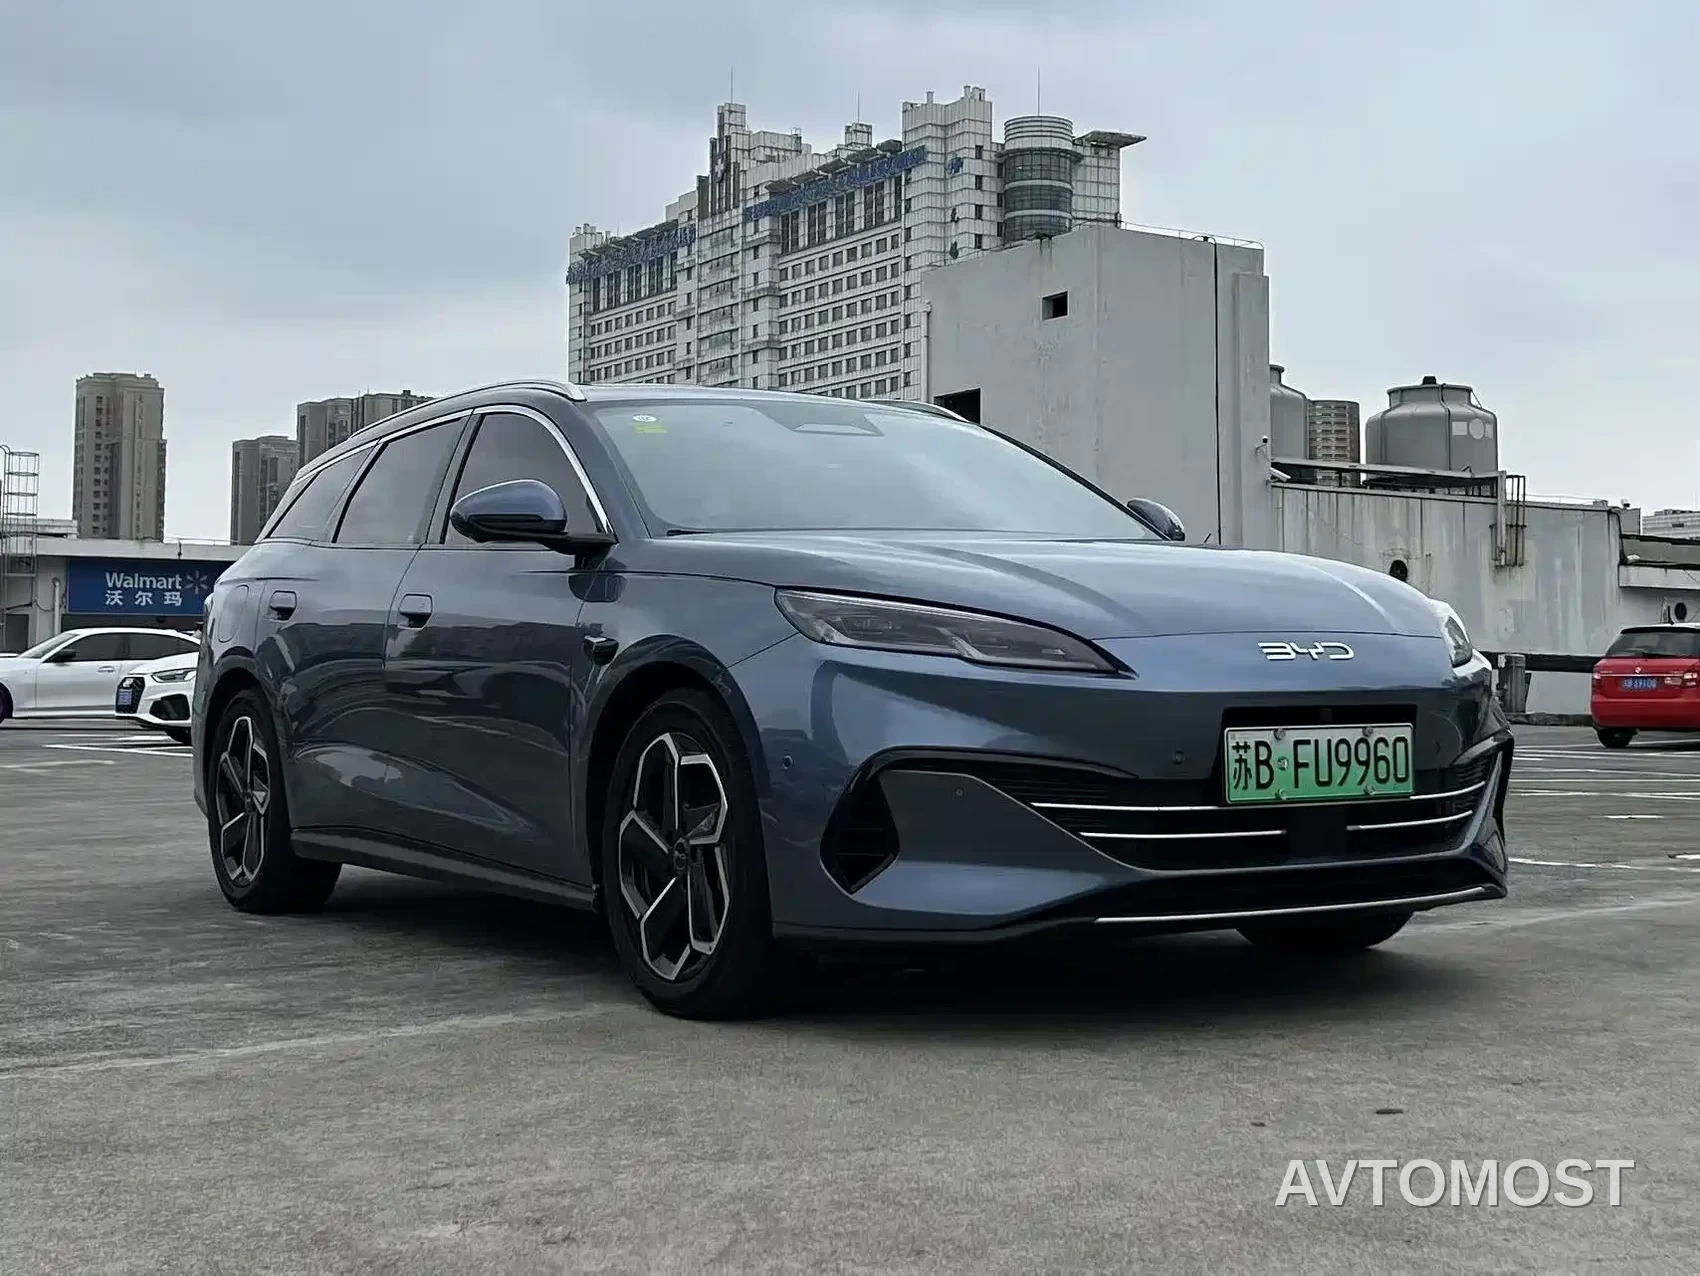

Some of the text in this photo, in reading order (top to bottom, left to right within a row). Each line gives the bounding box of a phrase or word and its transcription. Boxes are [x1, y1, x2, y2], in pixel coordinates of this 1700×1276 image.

[105, 571, 182, 590] Walmart
[105, 590, 182, 607] 沃尔玛
[1258, 642, 1355, 660] BYD
